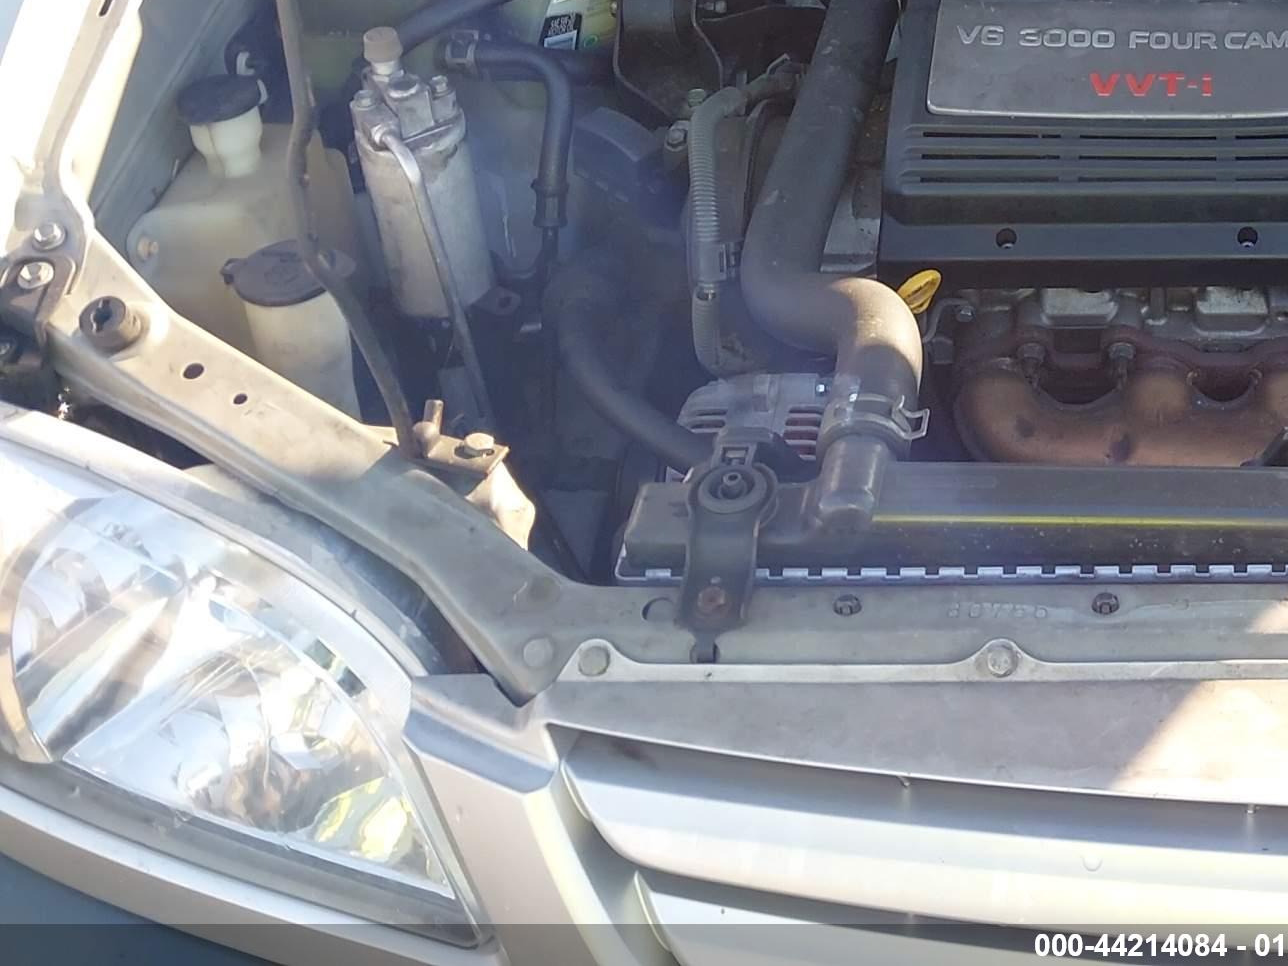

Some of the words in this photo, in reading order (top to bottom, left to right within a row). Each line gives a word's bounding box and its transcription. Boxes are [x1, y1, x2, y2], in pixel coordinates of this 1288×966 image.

[956, 25, 1005, 46] V6
[1019, 28, 1115, 49] 3000
[1128, 31, 1217, 50] FOUR
[1090, 72, 1213, 97] VVT-i
